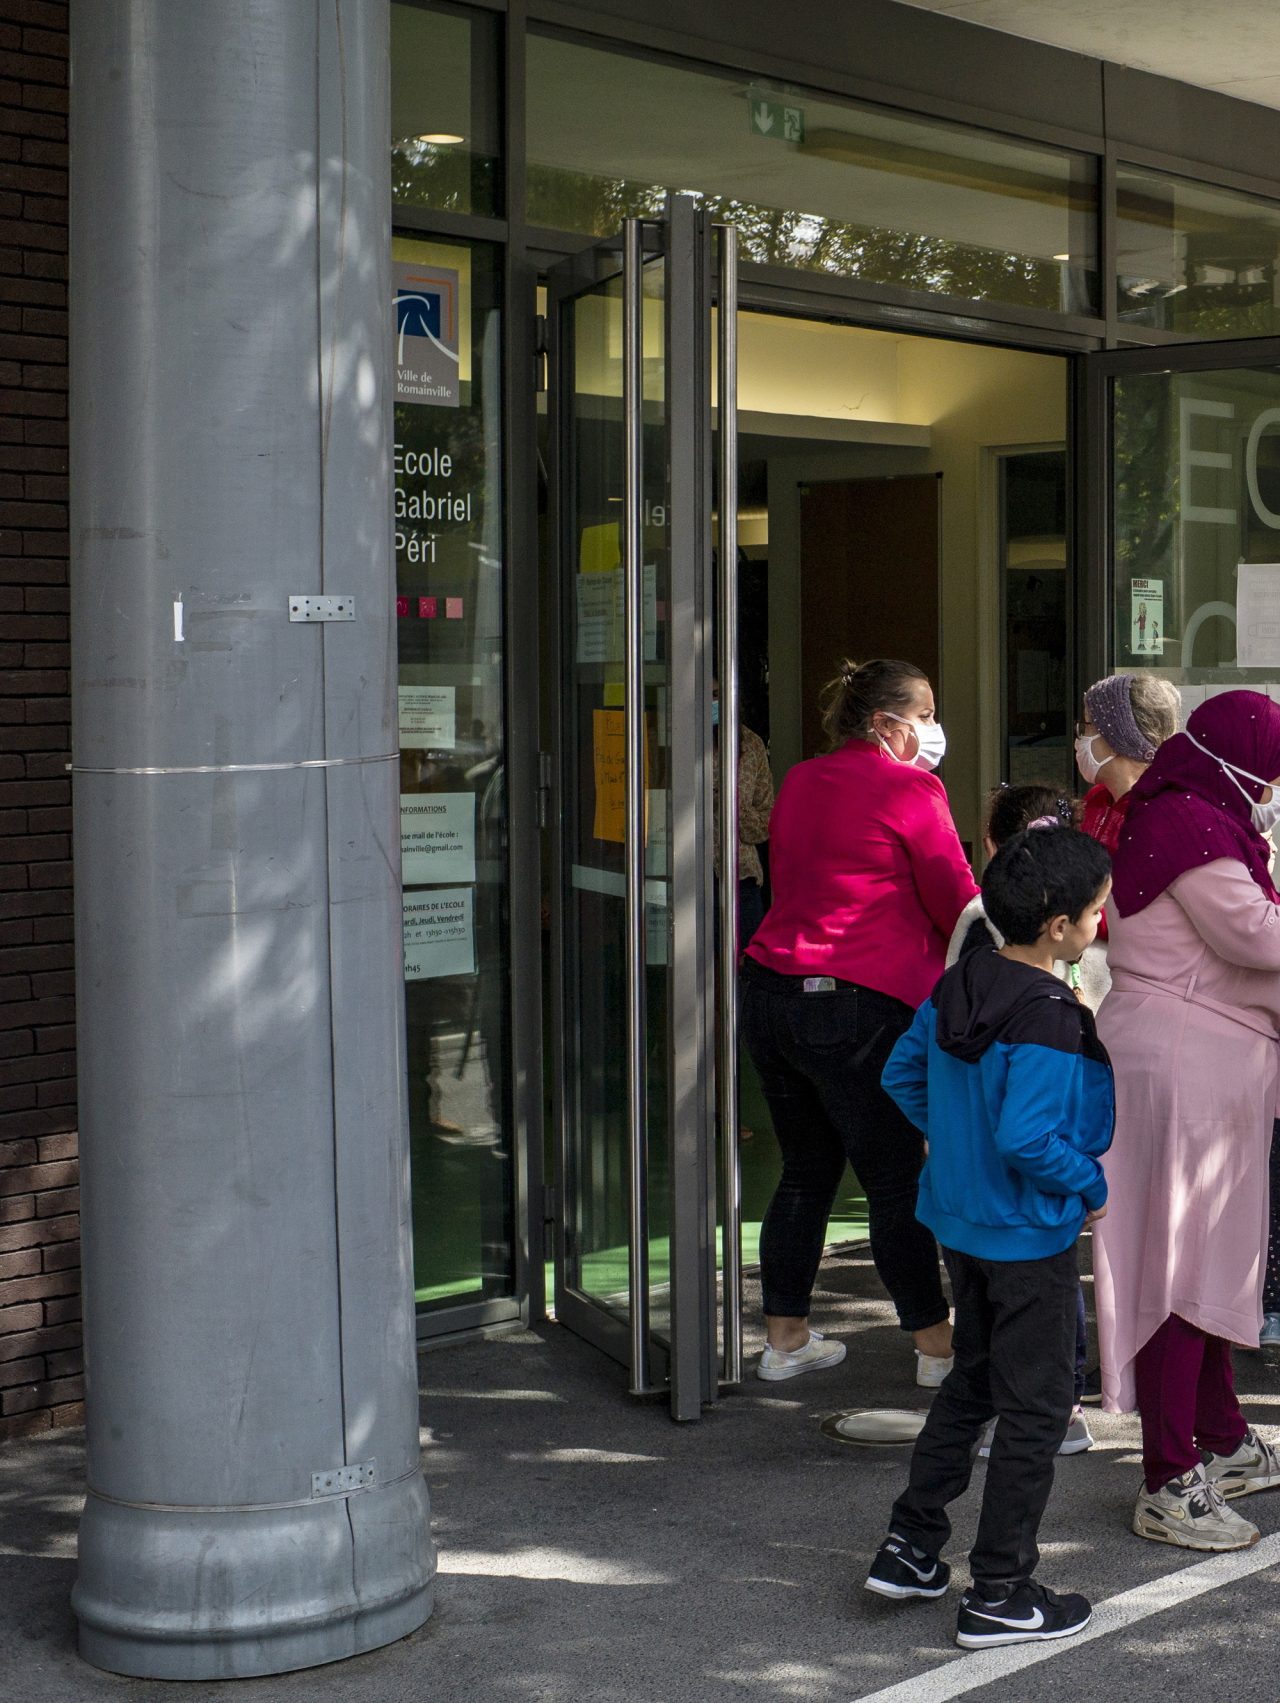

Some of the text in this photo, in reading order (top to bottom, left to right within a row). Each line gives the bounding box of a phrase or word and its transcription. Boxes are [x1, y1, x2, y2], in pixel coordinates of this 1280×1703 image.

[397, 369, 432, 383] Ville de
[397, 382, 452, 397] Romainville
[394, 444, 452, 477] Ecole
[394, 487, 471, 521] Gabriel
[395, 532, 435, 563] Péri
[400, 806, 447, 814] NFORMATIONS
[412, 831, 425, 840] mail
[401, 844, 463, 854] ainville@gmail.com
[402, 901, 465, 912] ORAIRES DE L'ECOLE
[404, 917, 417, 926] ardi,
[405, 964, 421, 973] 1h45
